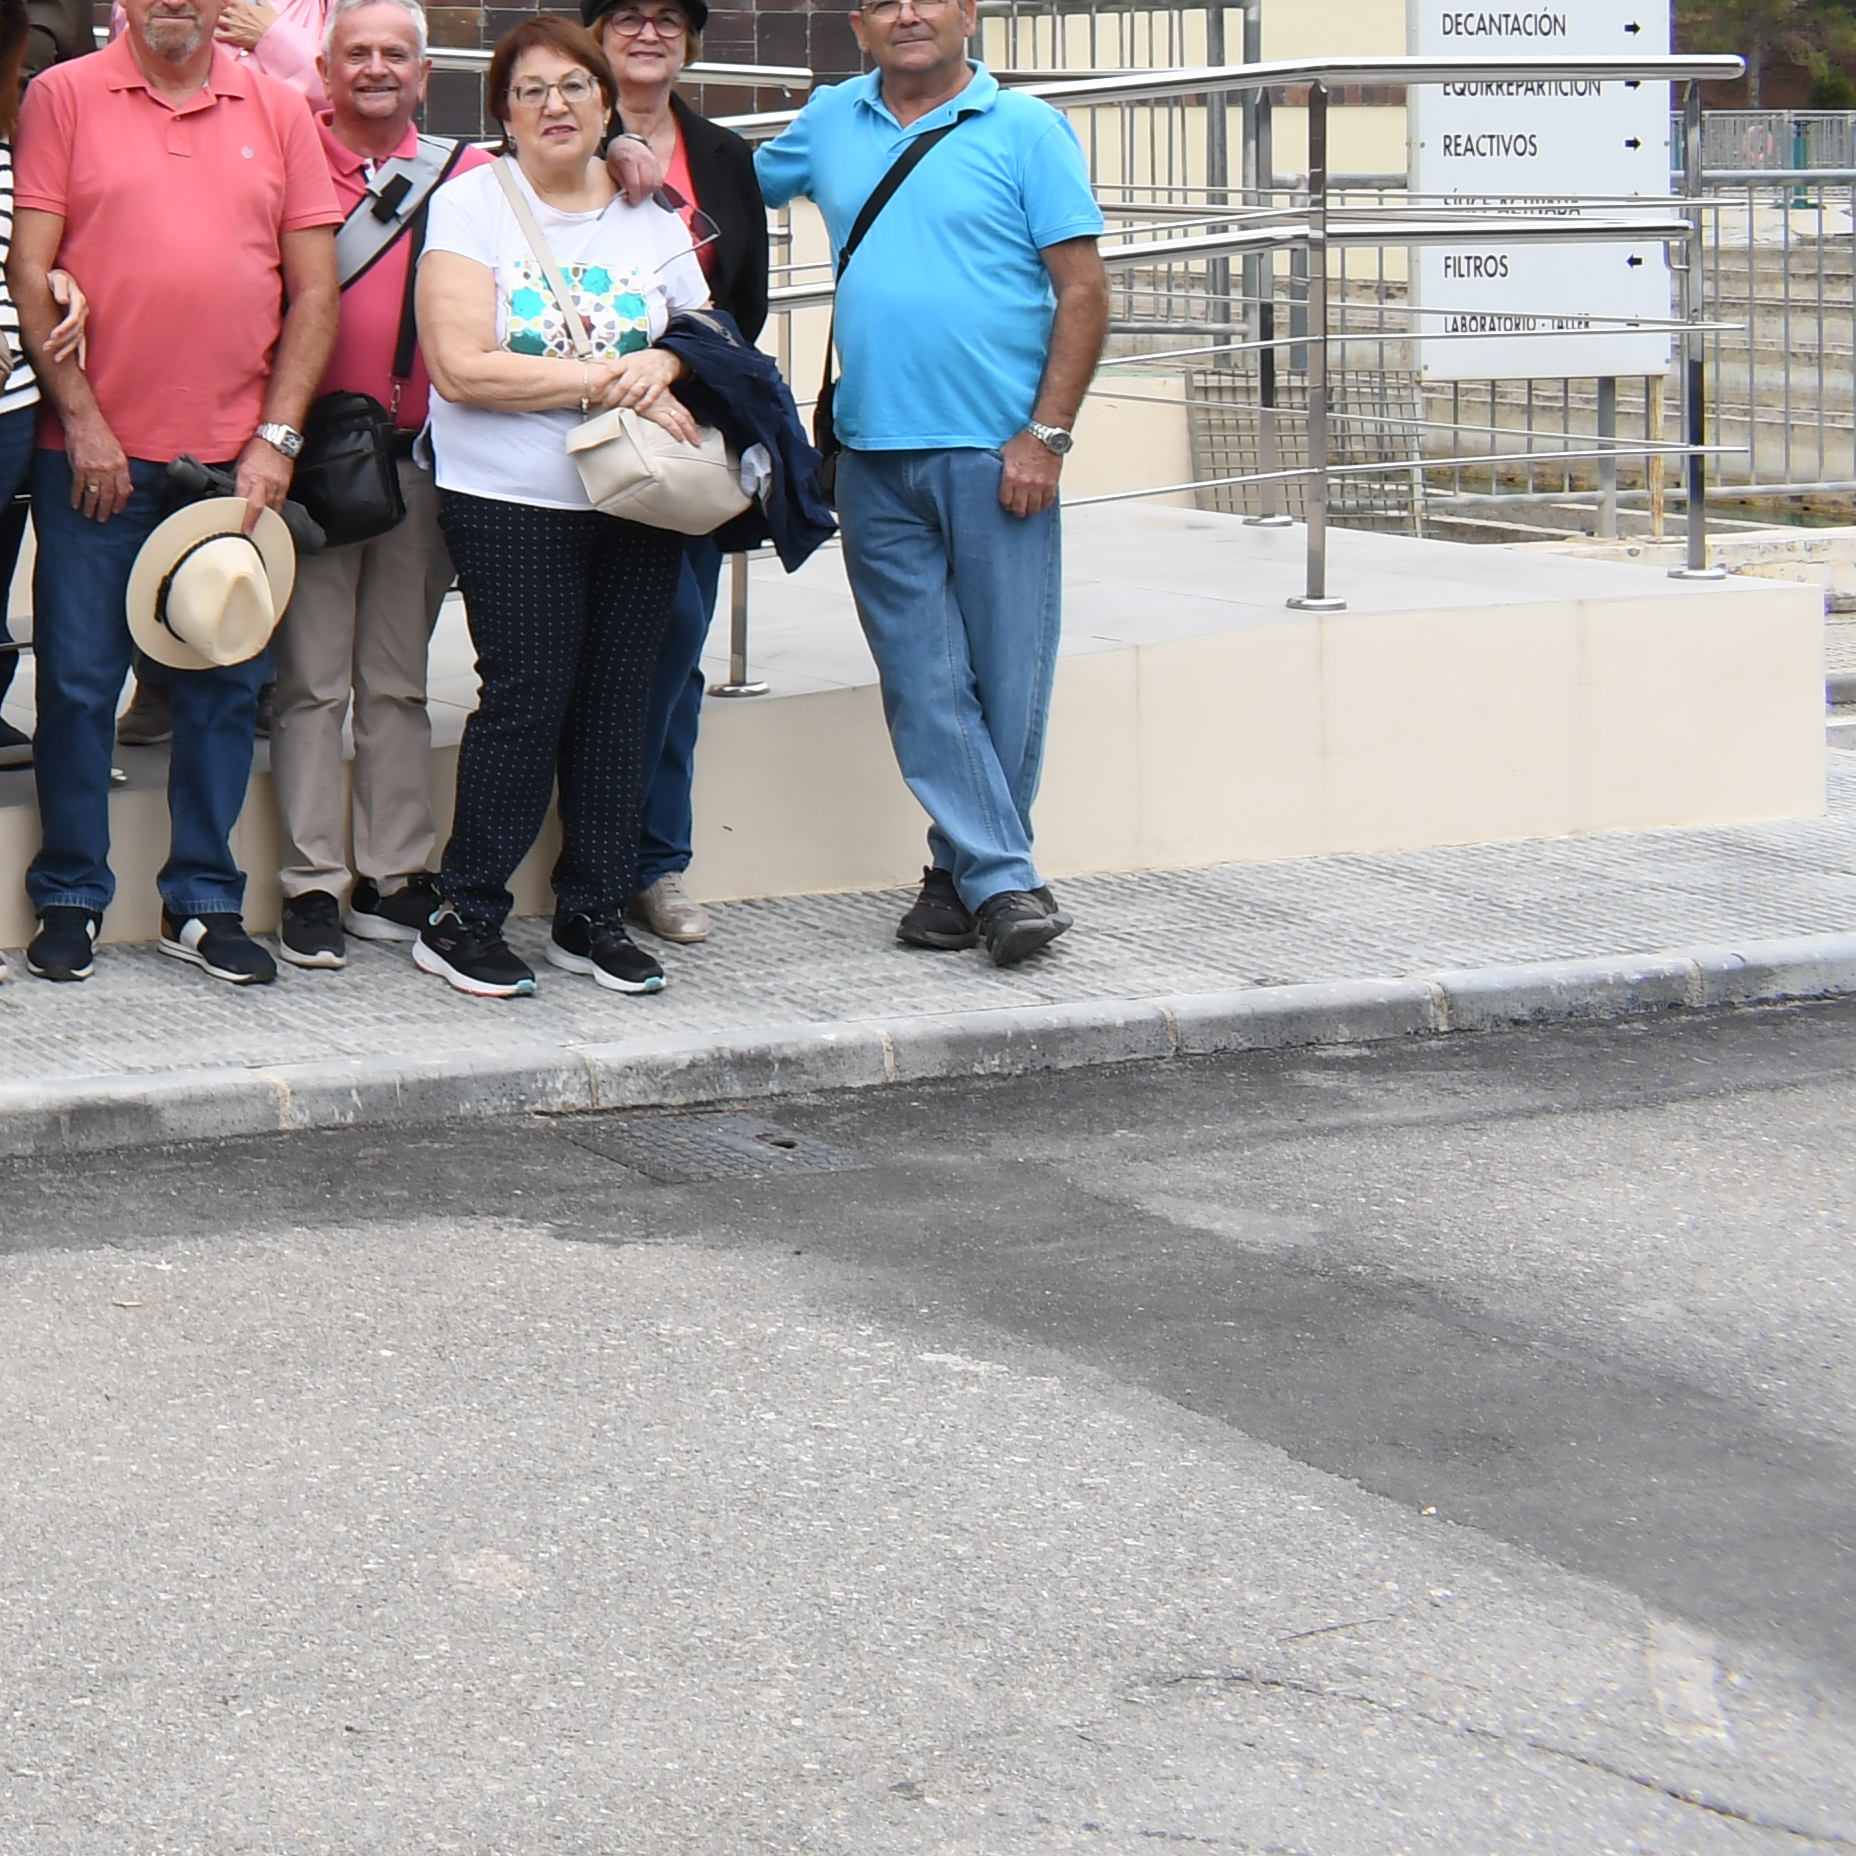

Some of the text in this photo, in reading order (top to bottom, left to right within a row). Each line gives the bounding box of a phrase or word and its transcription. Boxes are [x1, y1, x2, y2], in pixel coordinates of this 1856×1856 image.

[1442, 6, 1566, 37] DECANTACIÓN
[1443, 134, 1538, 157] REACTIVOS
[1443, 254, 1509, 278] FILTROS
